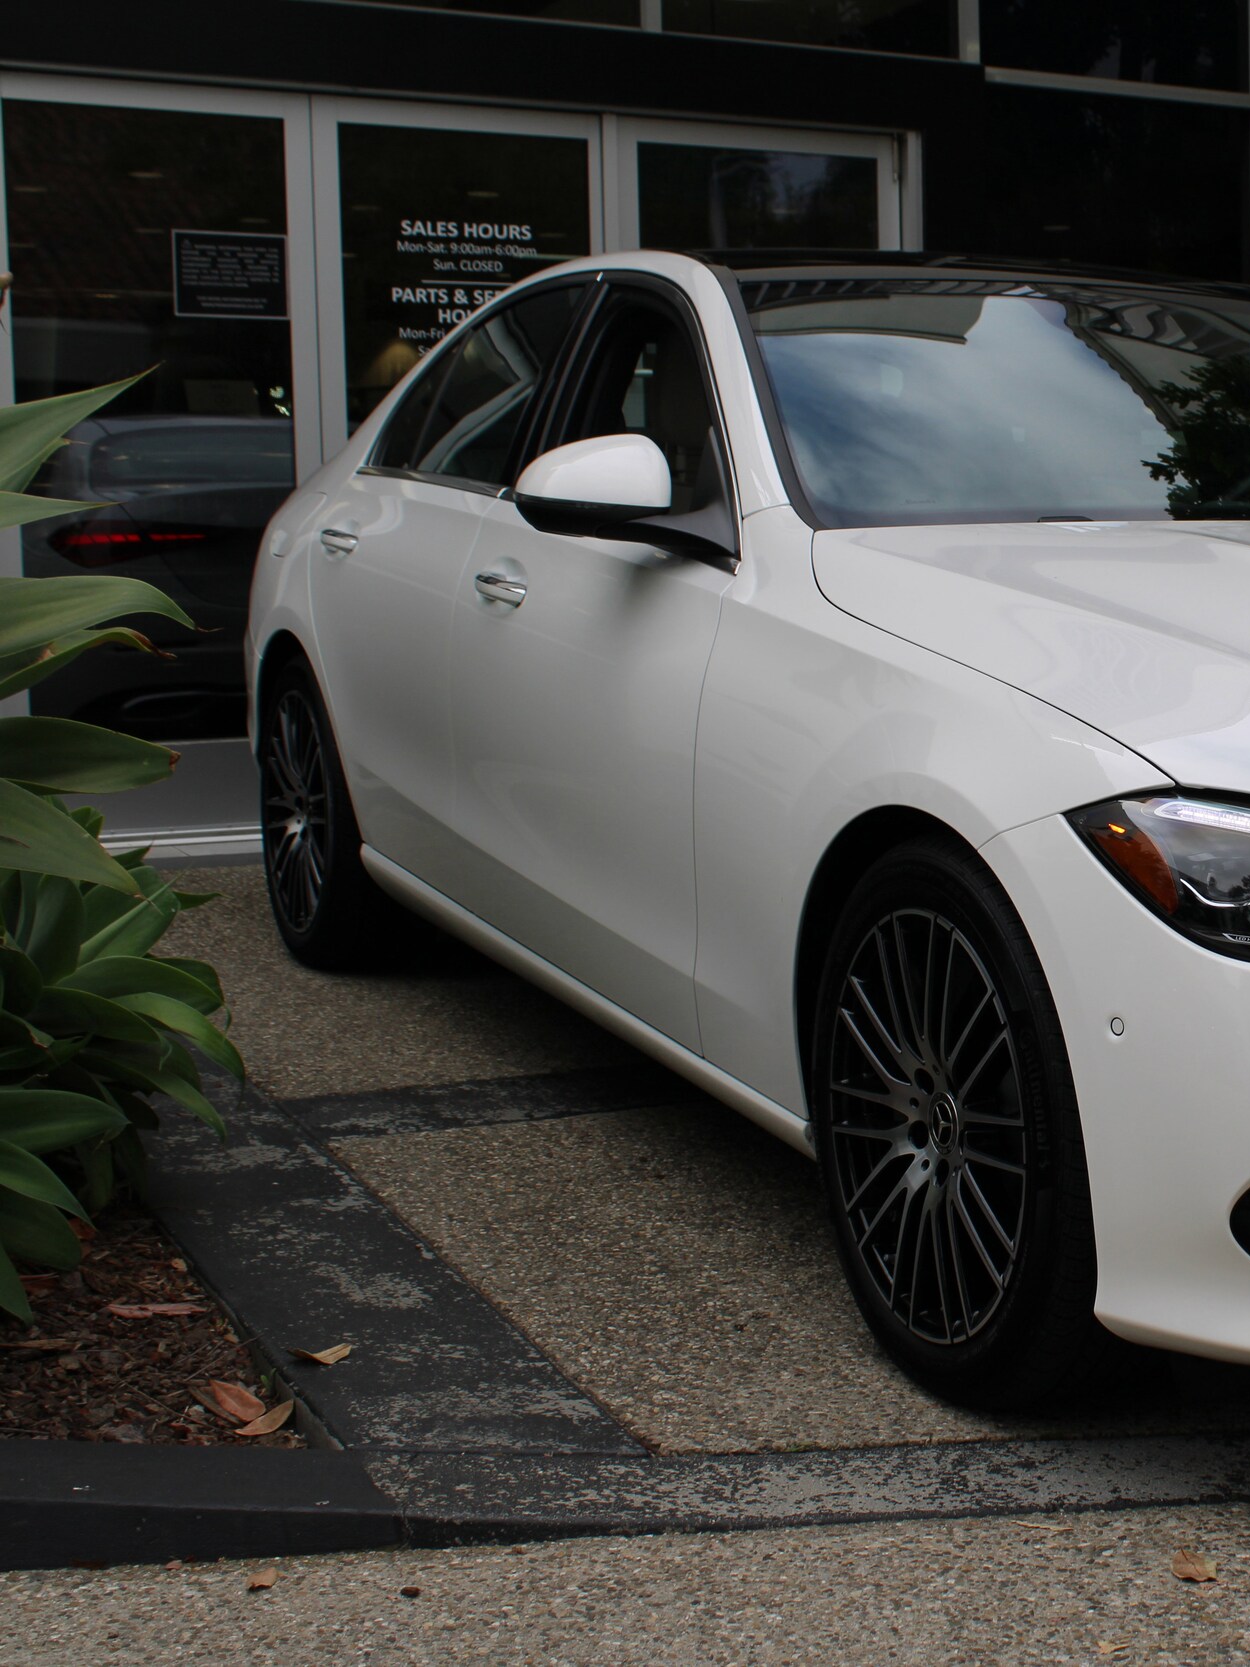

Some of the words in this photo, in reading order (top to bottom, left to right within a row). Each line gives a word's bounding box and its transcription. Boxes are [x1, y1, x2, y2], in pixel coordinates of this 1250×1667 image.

[400, 219, 460, 238] SALES
[464, 223, 532, 240] HOURS
[450, 242, 537, 259] 9:00am-6:00pm
[433, 258, 457, 271] Sun.
[460, 260, 504, 273] CLOSED
[391, 286, 449, 304] PARTS
[453, 288, 469, 305] &
